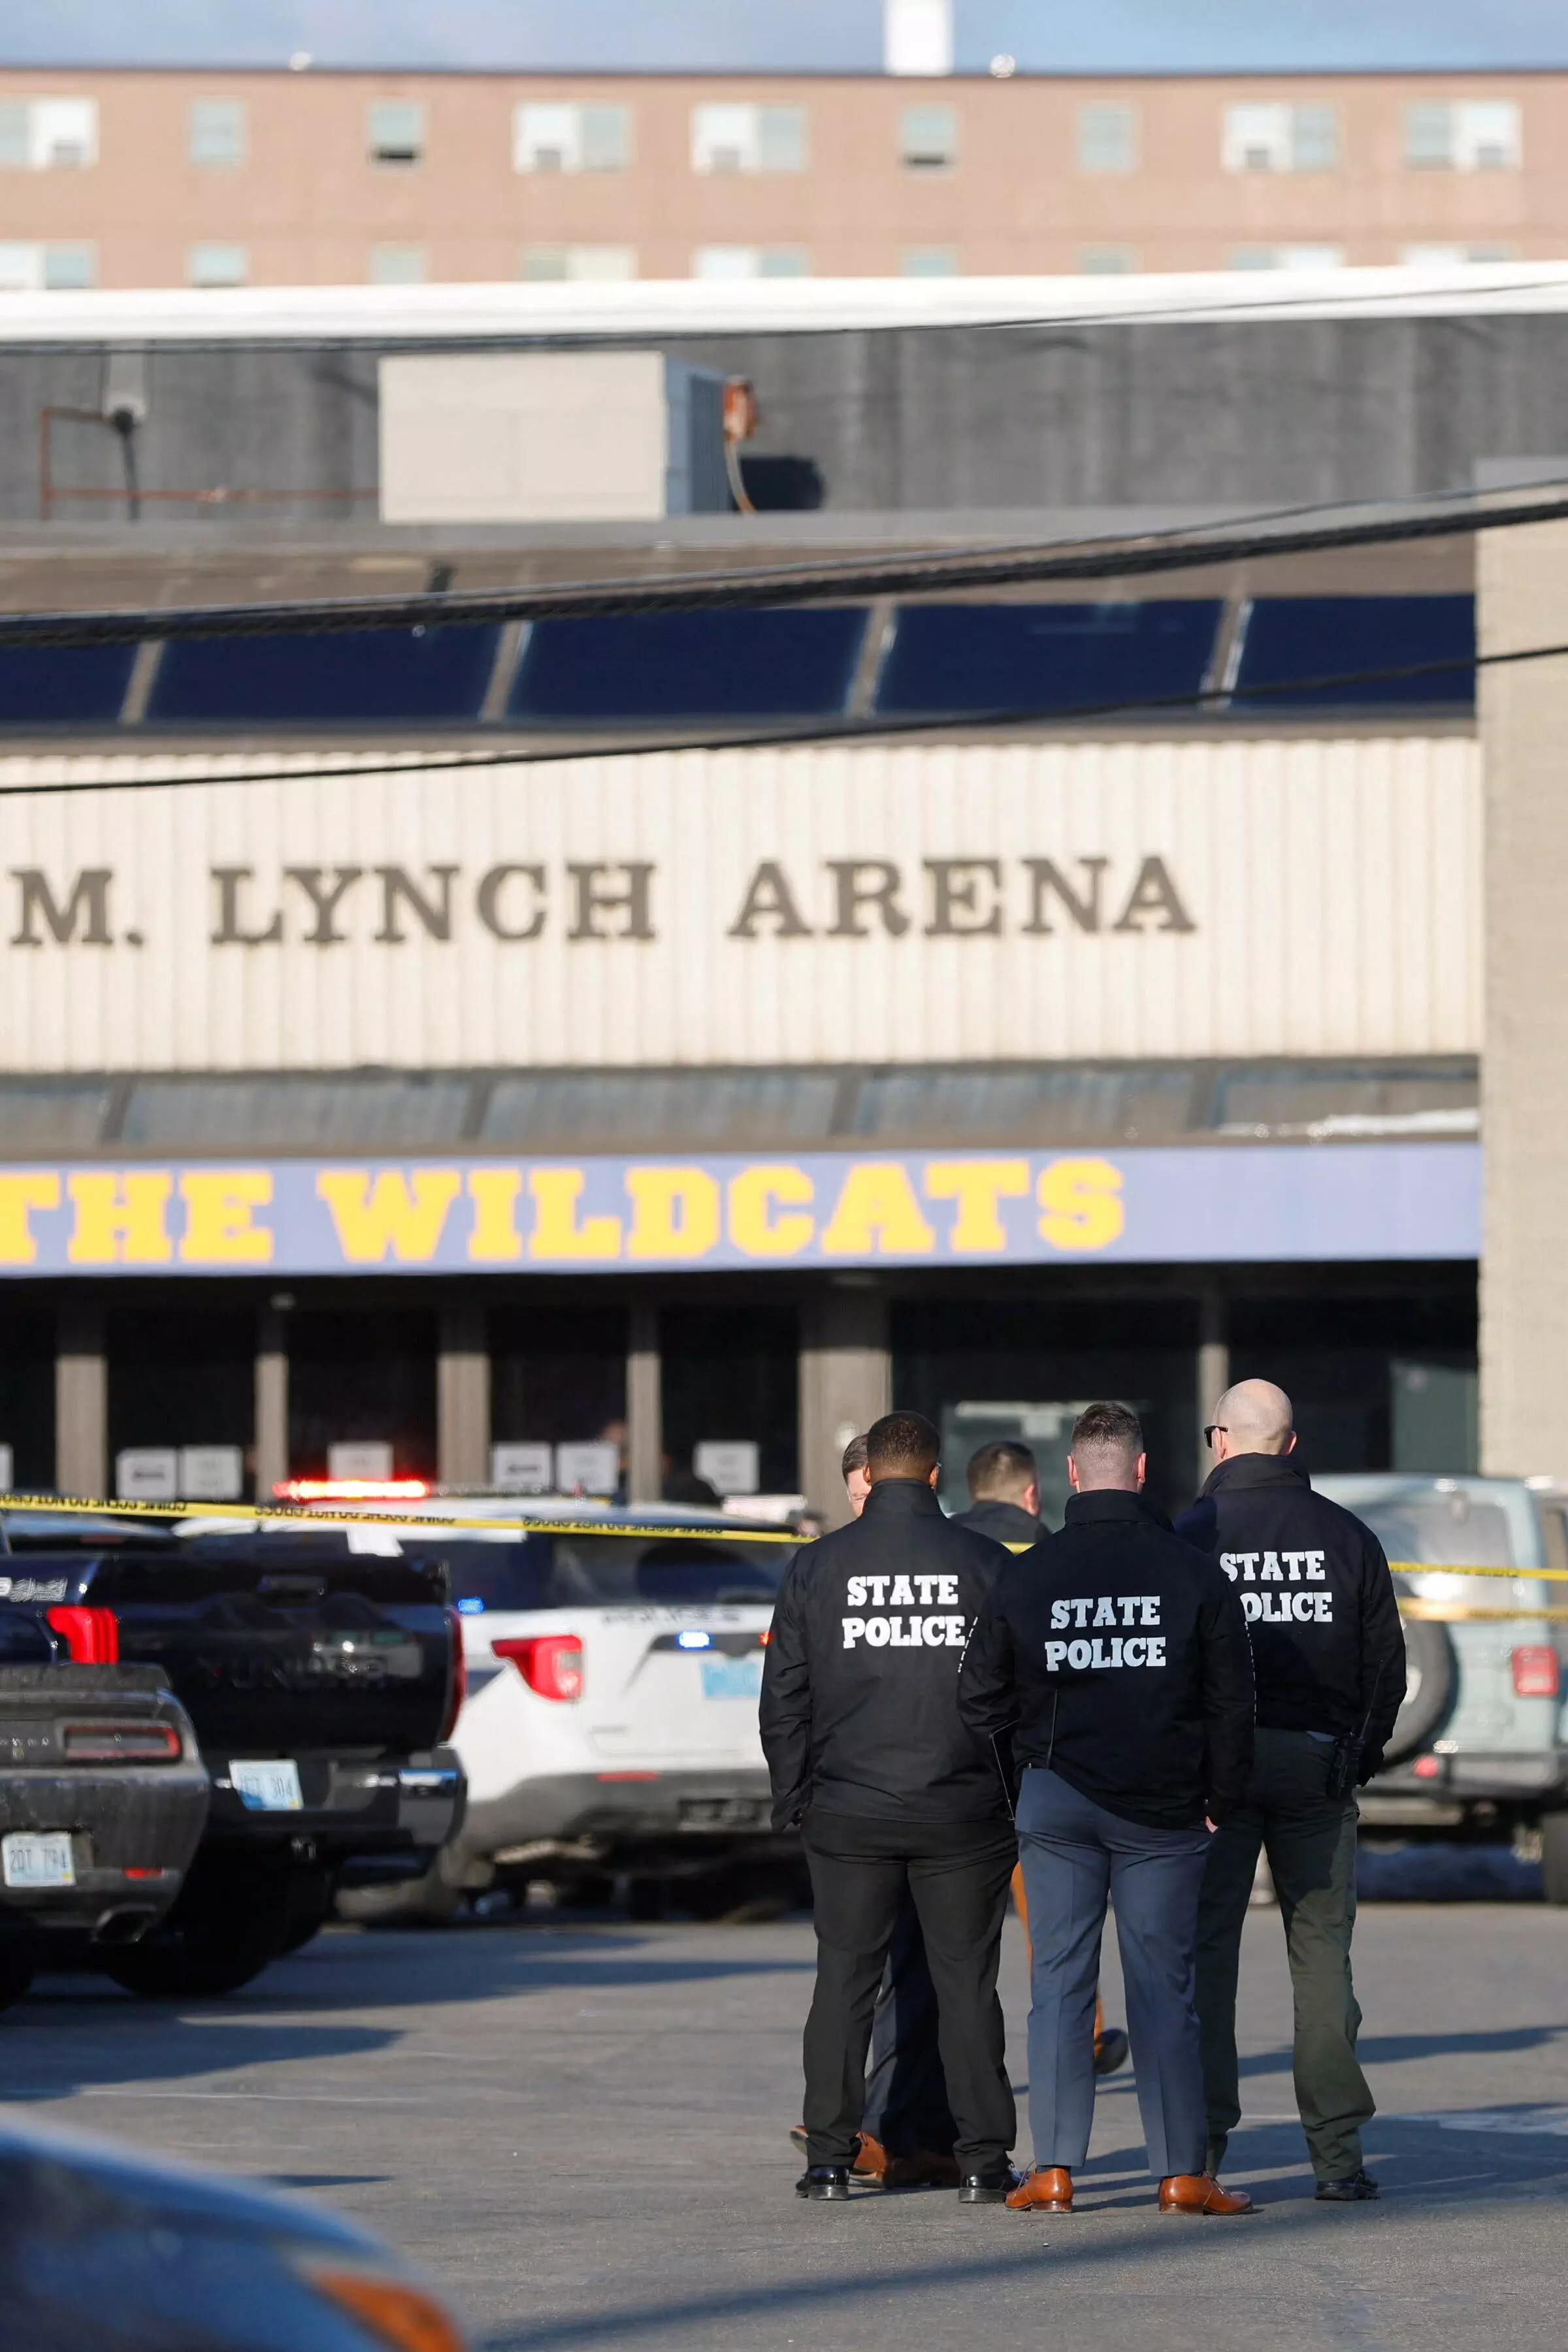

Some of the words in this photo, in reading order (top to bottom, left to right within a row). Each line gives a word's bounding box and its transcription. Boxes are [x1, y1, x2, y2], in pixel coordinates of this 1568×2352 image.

[9, 866, 147, 949] M.
[208, 860, 657, 951] LYNCH
[726, 855, 1198, 941] ARENA
[0, 1171, 273, 1263] THE
[316, 1159, 1124, 1262] WILDCATS
[1219, 1550, 1326, 1582] STATE
[847, 1575, 958, 1607] STATE
[1239, 1592, 1333, 1622] OLICE
[1051, 1595, 1160, 1629] STATE
[841, 1616, 966, 1649] POLICE
[1045, 1637, 1166, 1671] POLICE
